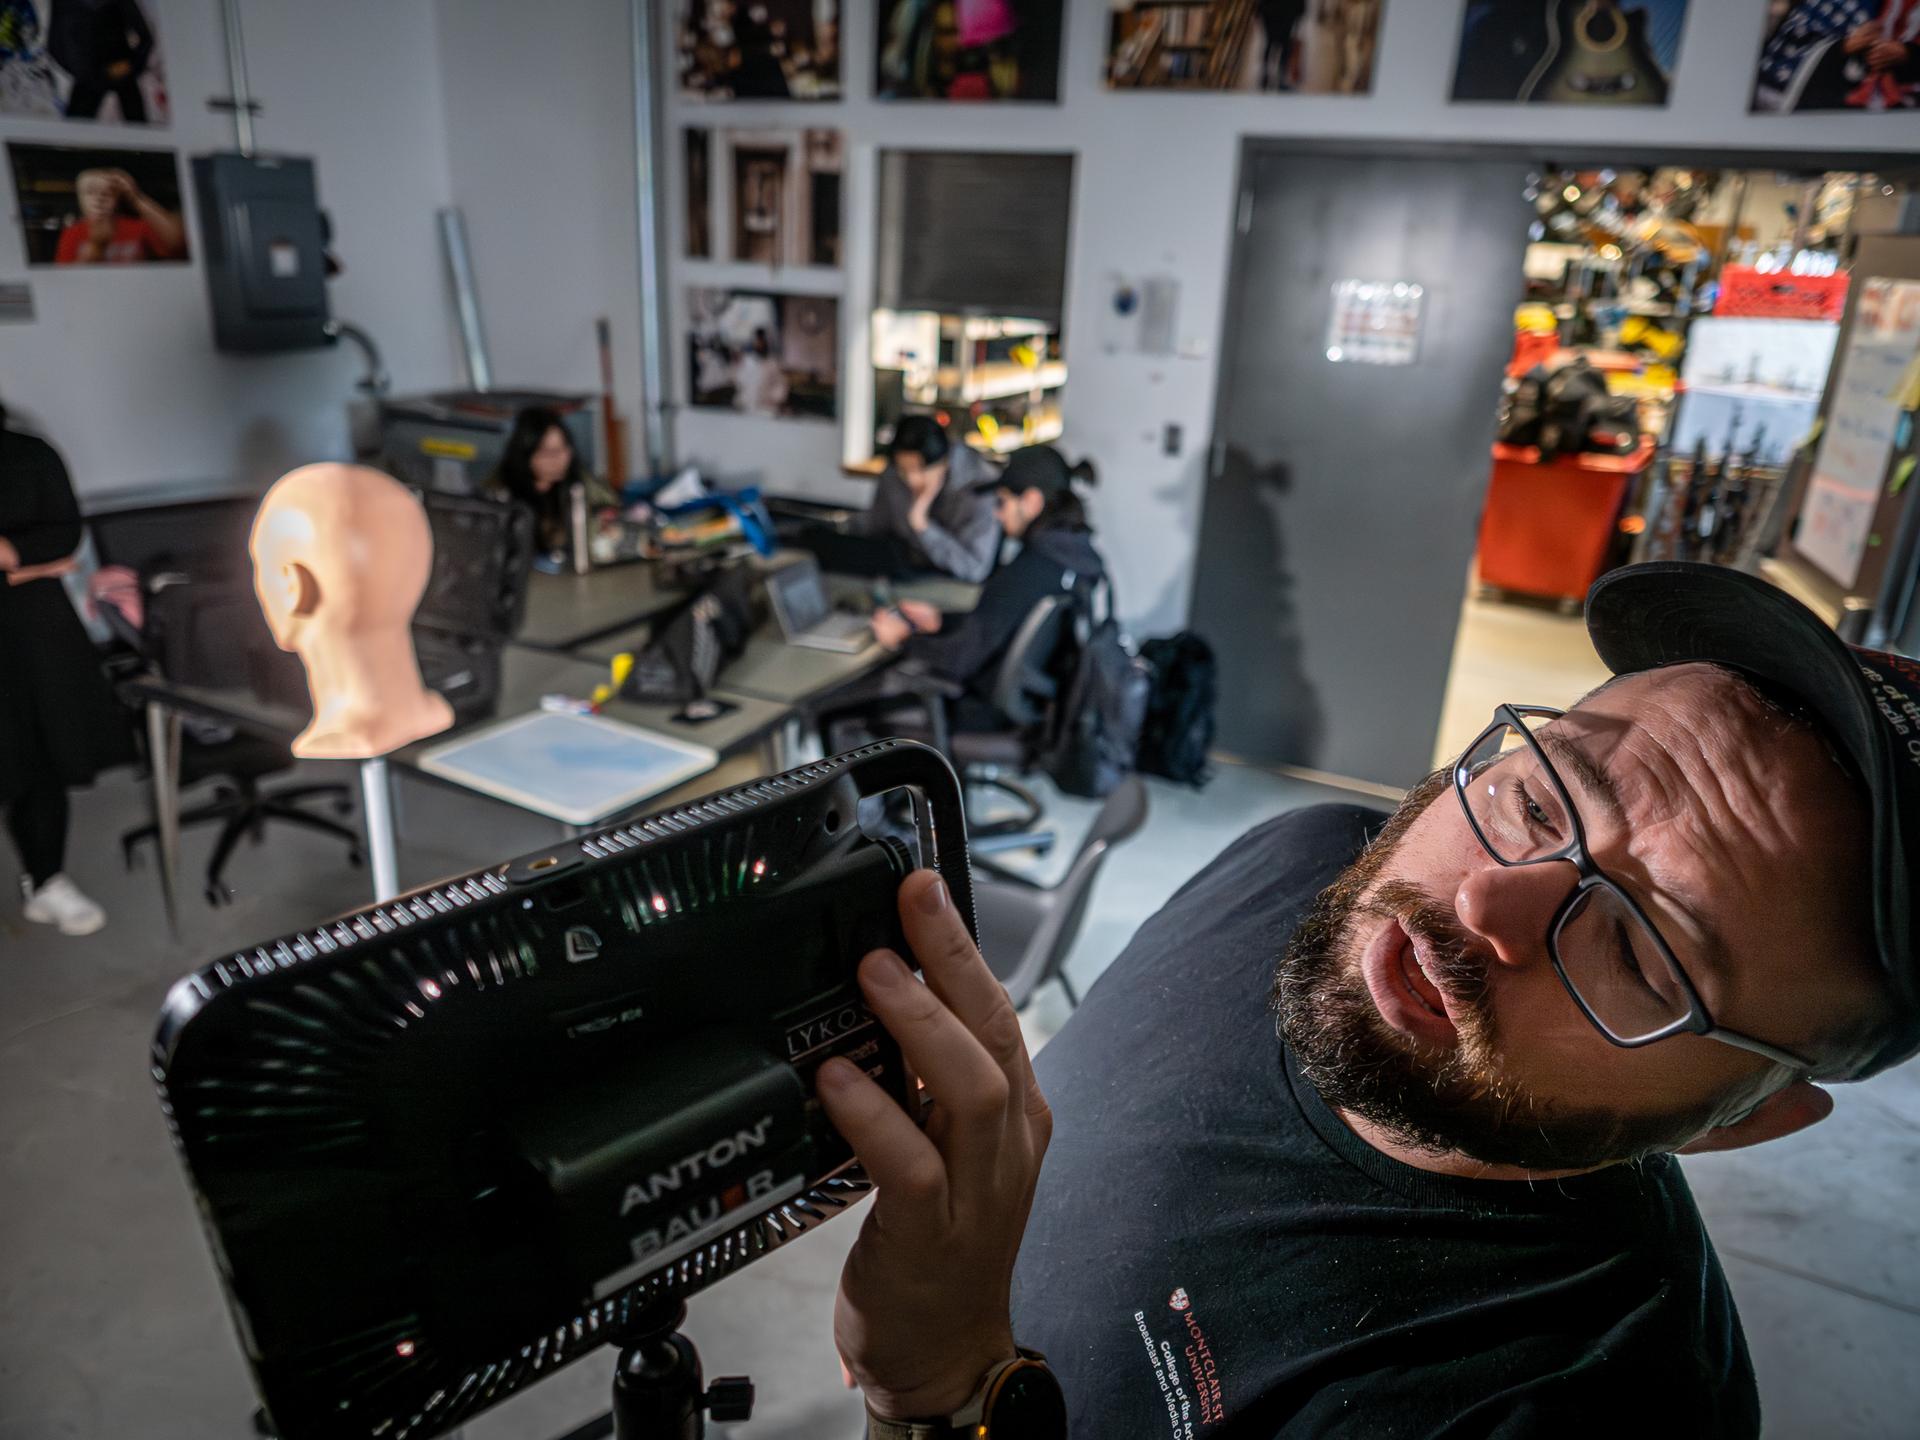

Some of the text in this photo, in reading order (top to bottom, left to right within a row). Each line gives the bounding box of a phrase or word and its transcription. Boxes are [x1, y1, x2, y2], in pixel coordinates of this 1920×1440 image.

[786, 1006, 872, 1057] LYKO
[1134, 1310, 1182, 1440] Broadcast and Media O
[1160, 1340, 1180, 1386] College
[1183, 1311, 1222, 1402] MONTCLAIR
[1175, 1387, 1190, 1401] of
[1184, 1344, 1213, 1425] UNIVERSITY
[1181, 1401, 1192, 1421] the
